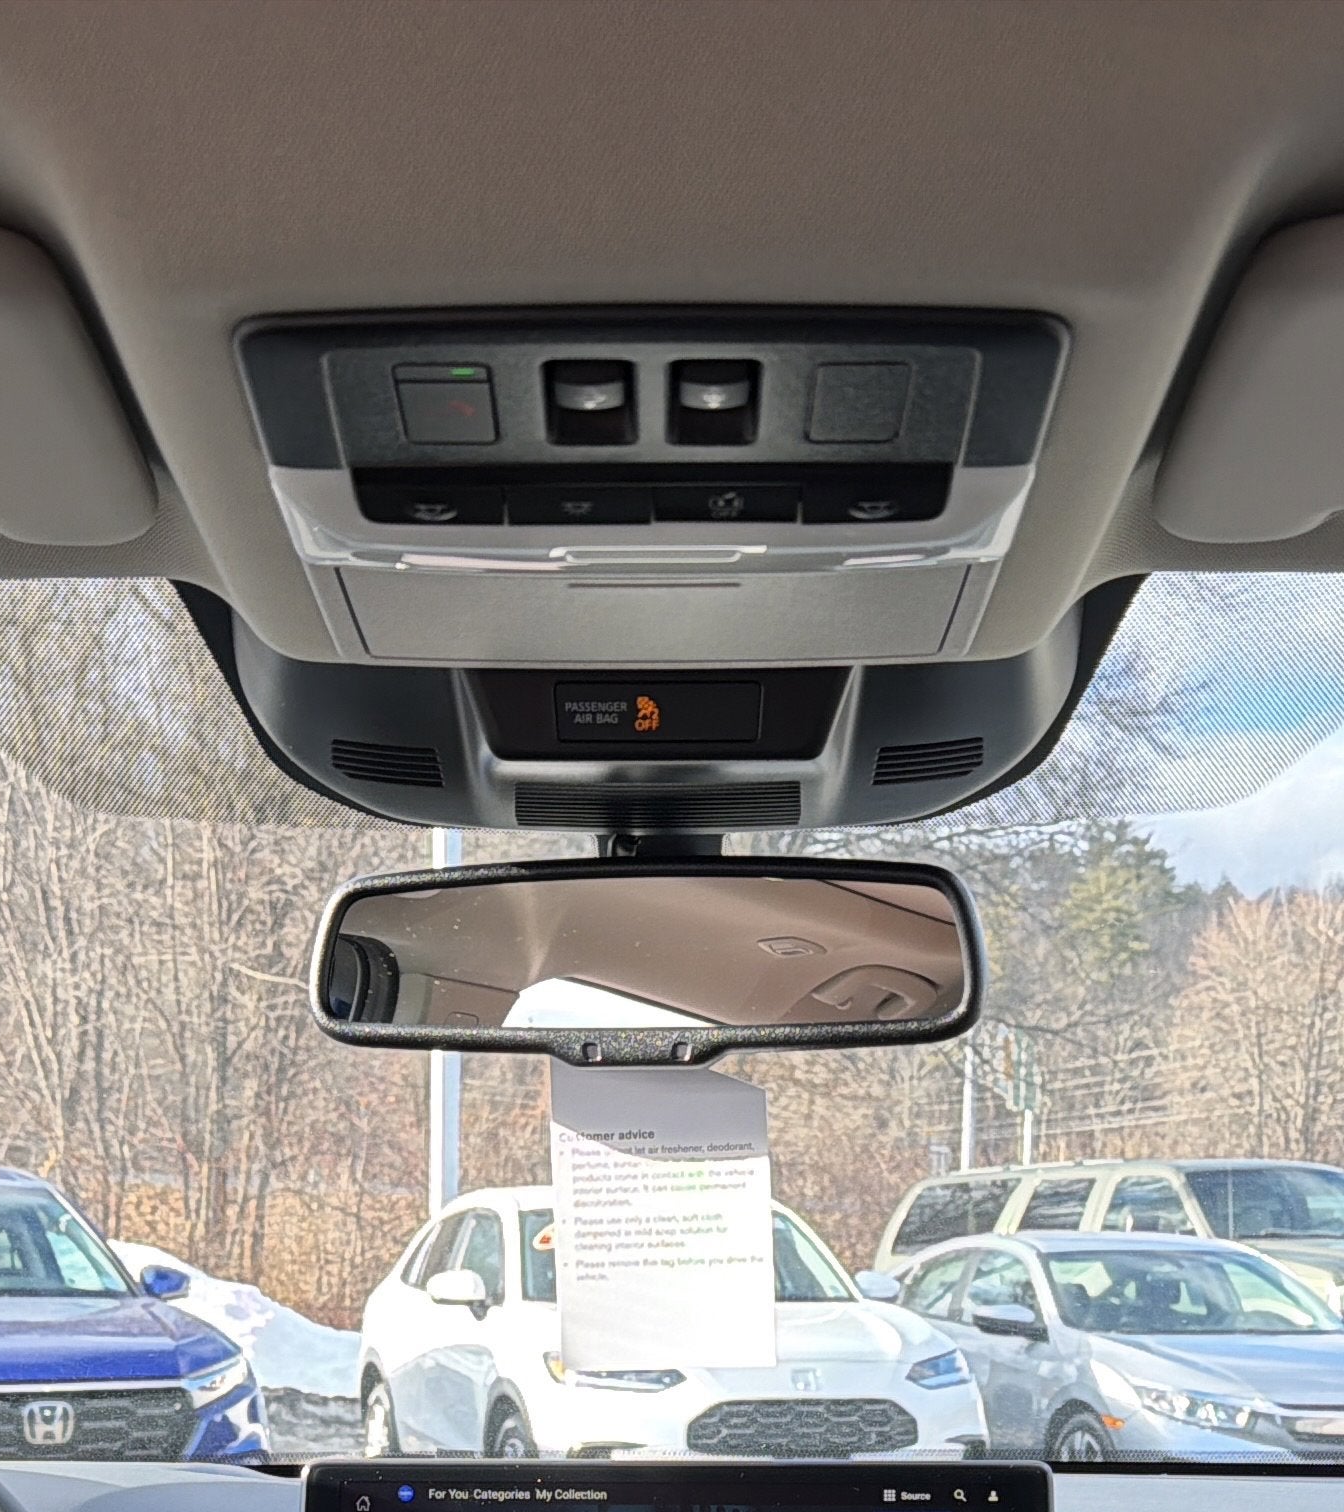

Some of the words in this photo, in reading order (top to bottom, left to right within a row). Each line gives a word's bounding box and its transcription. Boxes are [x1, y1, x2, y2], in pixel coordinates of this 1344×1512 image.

[565, 702, 628, 712] PASSENGER
[574, 714, 592, 723] AIR
[596, 714, 619, 724] BAG
[635, 720, 660, 731] OFF
[619, 1130, 655, 1141] advice
[648, 1146, 659, 1154] air
[661, 1144, 705, 1154] freshener,
[707, 1142, 755, 1152] deodorant,
[429, 1488, 446, 1500] For
[449, 1488, 469, 1500] You
[473, 1488, 531, 1502] Categories
[536, 1488, 553, 1502] My
[555, 1488, 608, 1500] Collection
[901, 1491, 932, 1501] Source
